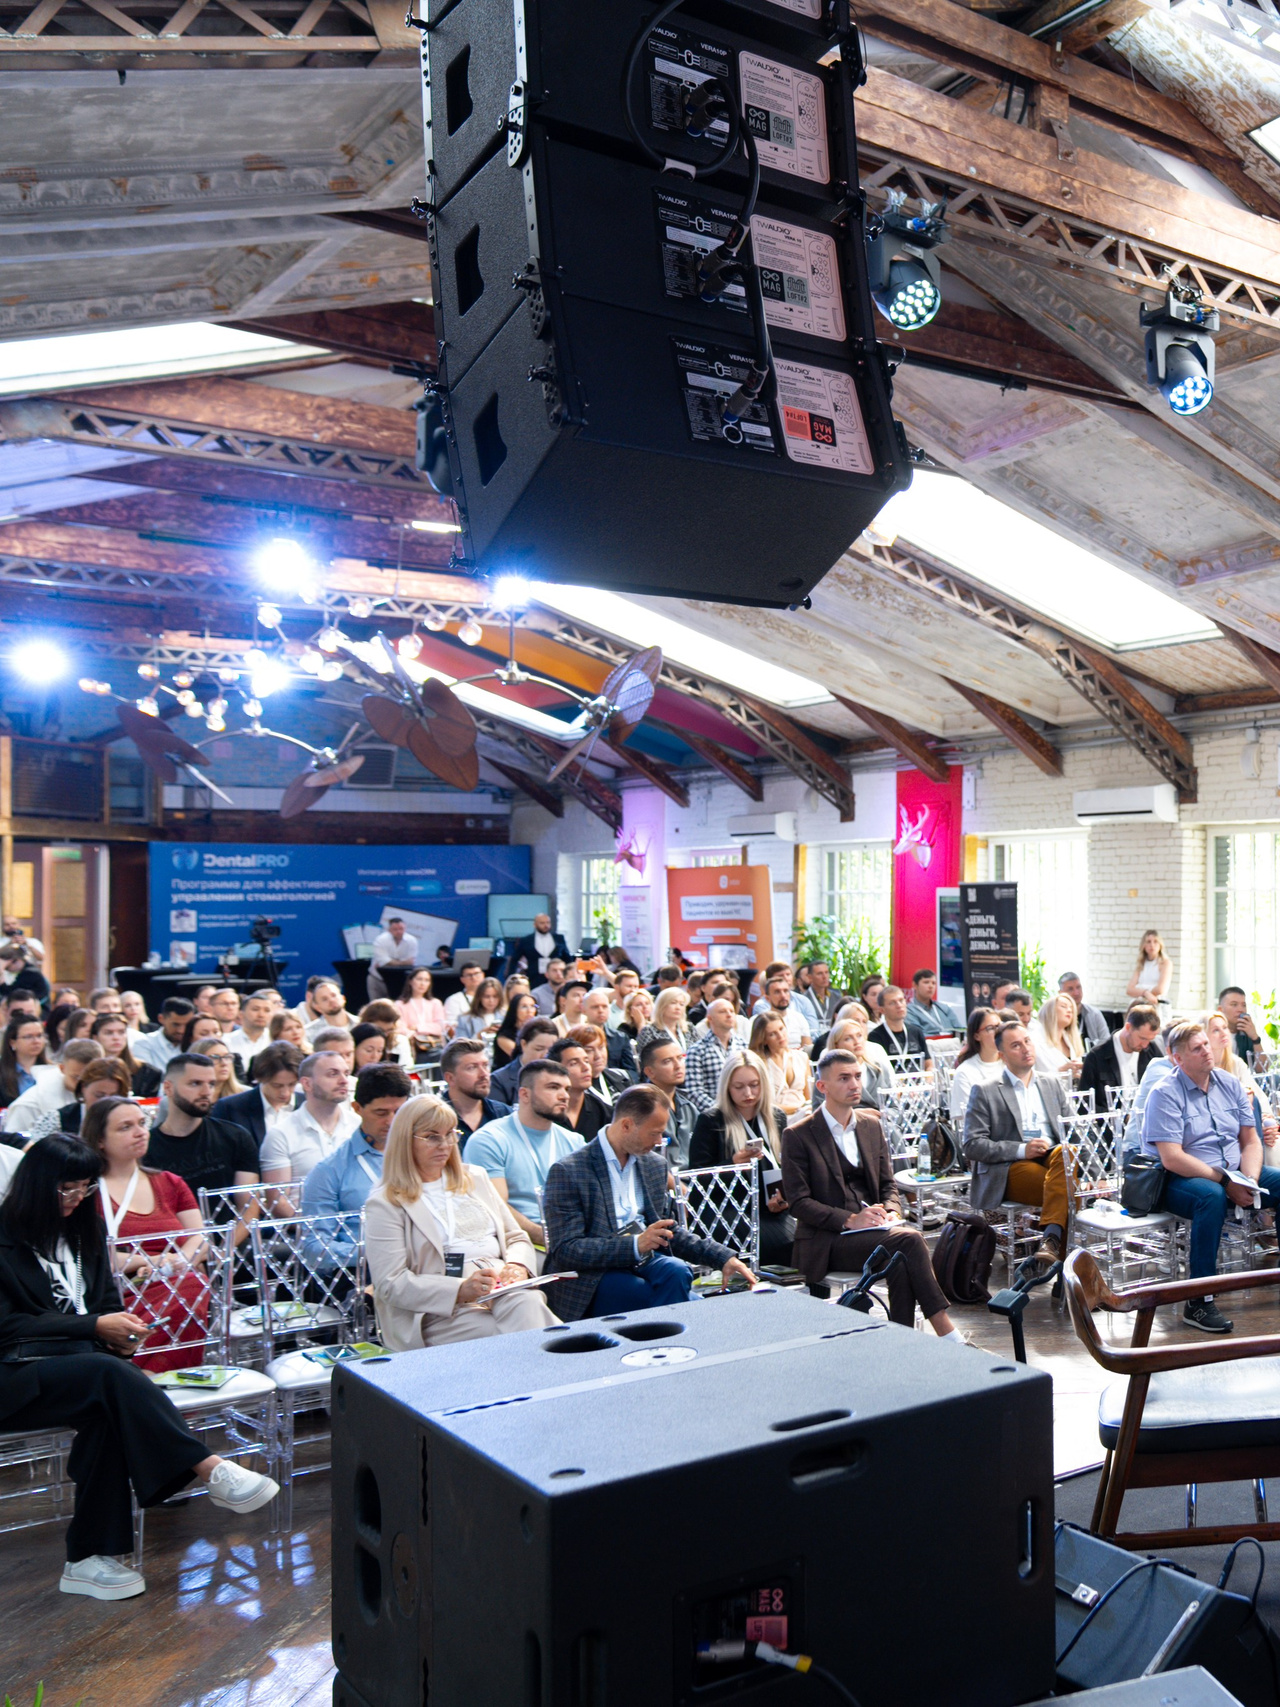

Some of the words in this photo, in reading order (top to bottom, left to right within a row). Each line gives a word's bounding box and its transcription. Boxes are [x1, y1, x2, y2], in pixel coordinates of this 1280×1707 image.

[700, 42, 728, 57] VERA10P
[745, 56, 780, 74] TWAUDIO
[748, 118, 767, 132] MAG
[772, 131, 793, 145] LOFT#2
[657, 193, 688, 207] TWAUDIO
[756, 220, 791, 235] TWAUDIO
[763, 279, 781, 293] MAG
[787, 292, 807, 304] LOFT#2
[674, 341, 706, 354] TWAUDIO
[775, 362, 810, 376] TWAUDIO
[785, 410, 808, 422] LOFT#4
[813, 421, 832, 434] MAG
[203, 853, 290, 868] DentalPRO
[171, 878, 240, 891] Программа
[242, 879, 265, 891] для
[267, 879, 347, 890] эффективного
[171, 892, 245, 904] управления
[246, 890, 336, 902] стоматологией
[969, 927, 998, 939] ДЕНЬГИ,
[759, 1588, 771, 1613] MAG
